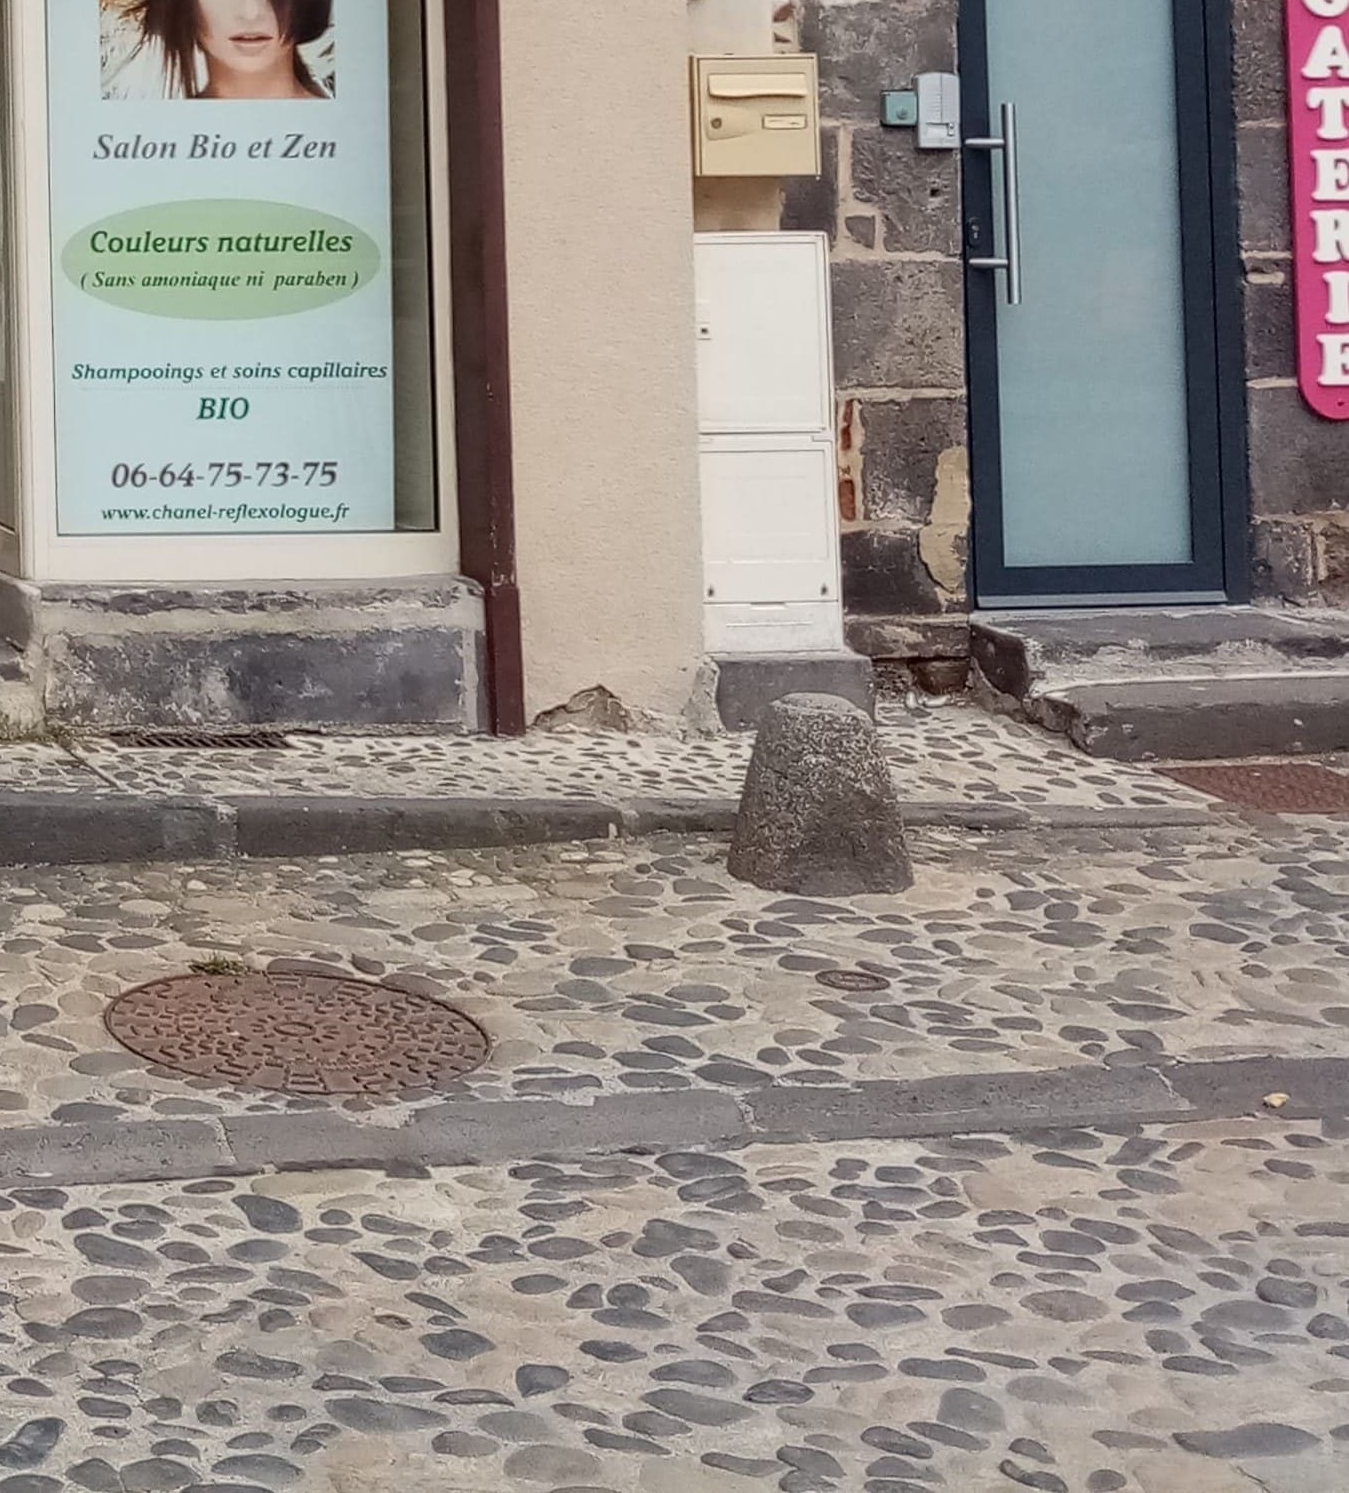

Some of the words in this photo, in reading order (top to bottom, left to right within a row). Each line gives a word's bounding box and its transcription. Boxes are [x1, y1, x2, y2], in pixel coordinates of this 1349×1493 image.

[93, 133, 177, 160] Salon
[187, 133, 237, 160] Bio
[247, 136, 274, 159] et
[281, 133, 337, 159] Zen
[90, 230, 210, 254] Couleurs
[216, 229, 354, 253] naturelles
[140, 270, 241, 291] amoniaque
[245, 270, 264, 287] ni
[71, 362, 204, 383] Shampooings
[210, 363, 228, 379] et
[232, 362, 282, 379] soins
[287, 362, 388, 382] capillaires
[197, 397, 251, 420] BIO
[111, 461, 338, 488] 06-64-75-73-75
[101, 502, 350, 524] www.chanel-reflexologue.fr
